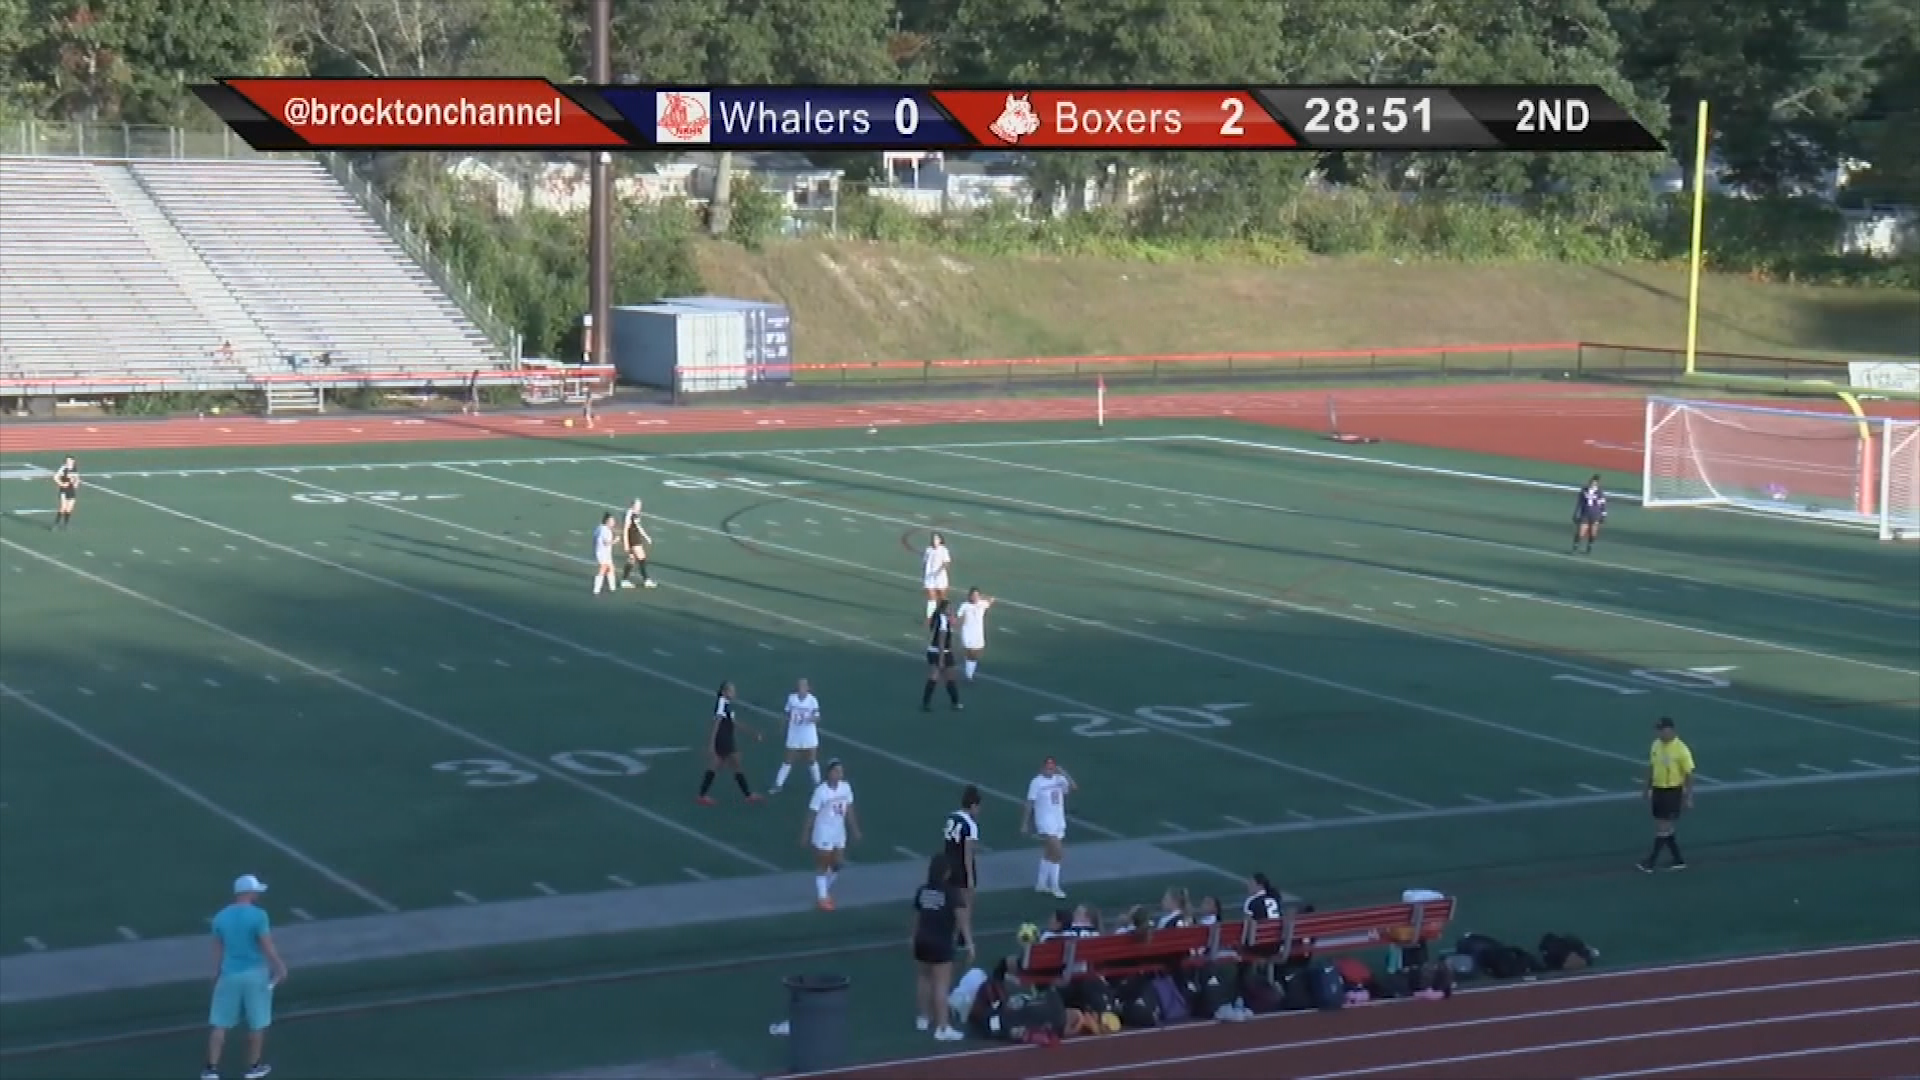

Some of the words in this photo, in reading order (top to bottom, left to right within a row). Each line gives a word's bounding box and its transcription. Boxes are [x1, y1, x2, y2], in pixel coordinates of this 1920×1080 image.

[1034, 705, 1232, 738] 20
[432, 751, 651, 787] 30
[944, 818, 963, 843] 24
[1264, 898, 1280, 919] 2
